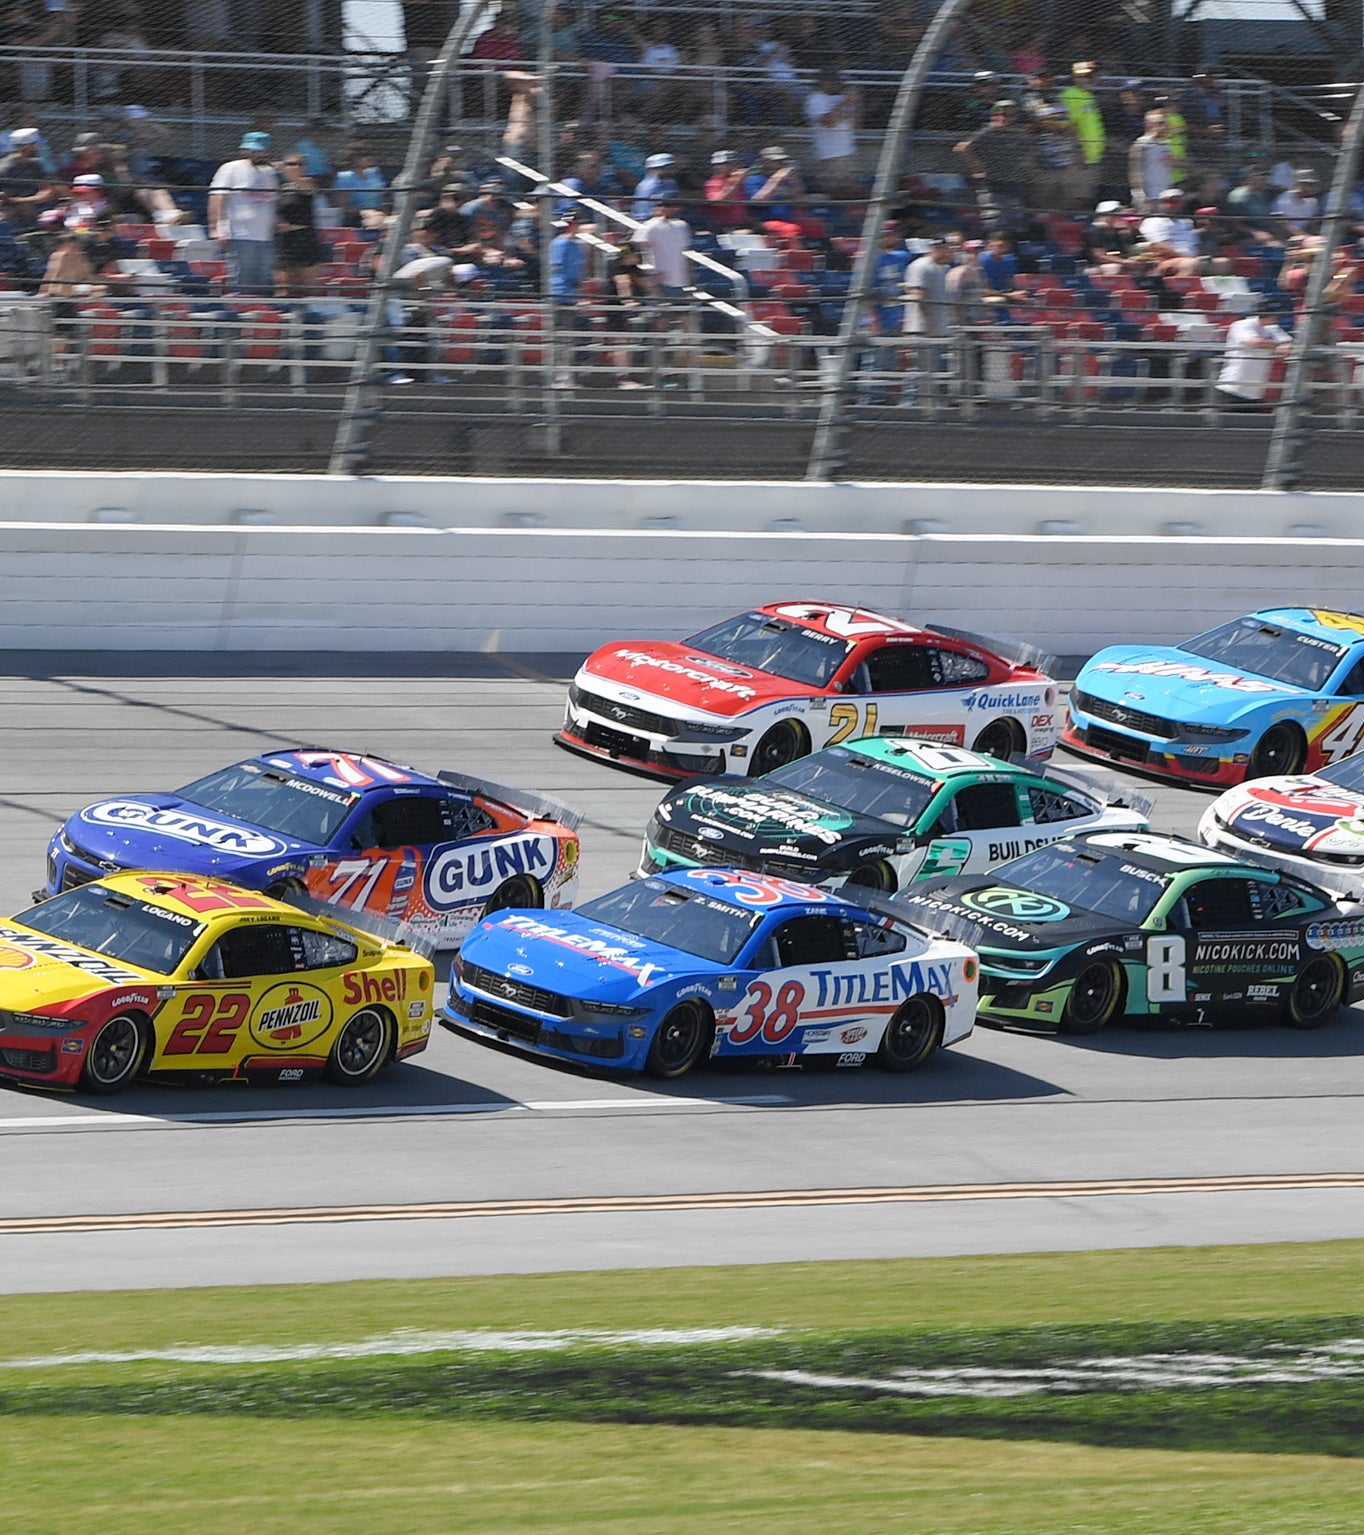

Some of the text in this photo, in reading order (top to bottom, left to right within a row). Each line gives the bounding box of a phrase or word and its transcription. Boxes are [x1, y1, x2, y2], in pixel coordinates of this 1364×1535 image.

[801, 628, 839, 646] BERRY
[1297, 634, 1343, 653] CUSTER
[613, 648, 758, 702] Motorcraft
[823, 702, 878, 749] 21
[1031, 714, 1054, 728] DEX
[909, 730, 960, 746] Motorcraft
[873, 762, 933, 788] KESELOWSK
[286, 778, 352, 806] MCDOWELL
[106, 805, 253, 850] GUNK
[438, 837, 548, 893] GUNK
[1119, 863, 1168, 887] BUSCH
[327, 857, 390, 912] 71
[141, 903, 193, 928] LOGANO
[707, 900, 749, 919] SMITH
[908, 894, 1032, 943] NICOKICK.COM
[1194, 942, 1301, 962] NICOKICK.COM
[1147, 934, 1187, 1003] 8
[1227, 964, 1262, 974] POUCHES
[1262, 964, 1296, 974] ONLINE
[343, 968, 408, 1004] Shell
[675, 982, 713, 998] GOODYEAR
[1246, 984, 1281, 998] REBEL
[111, 992, 150, 1008] GOODYEAR
[727, 979, 806, 1046] 38
[163, 993, 252, 1056] 22
[257, 999, 322, 1034] PENNZOIL
[839, 1053, 867, 1063] FORD
[279, 1069, 304, 1078] FORD
